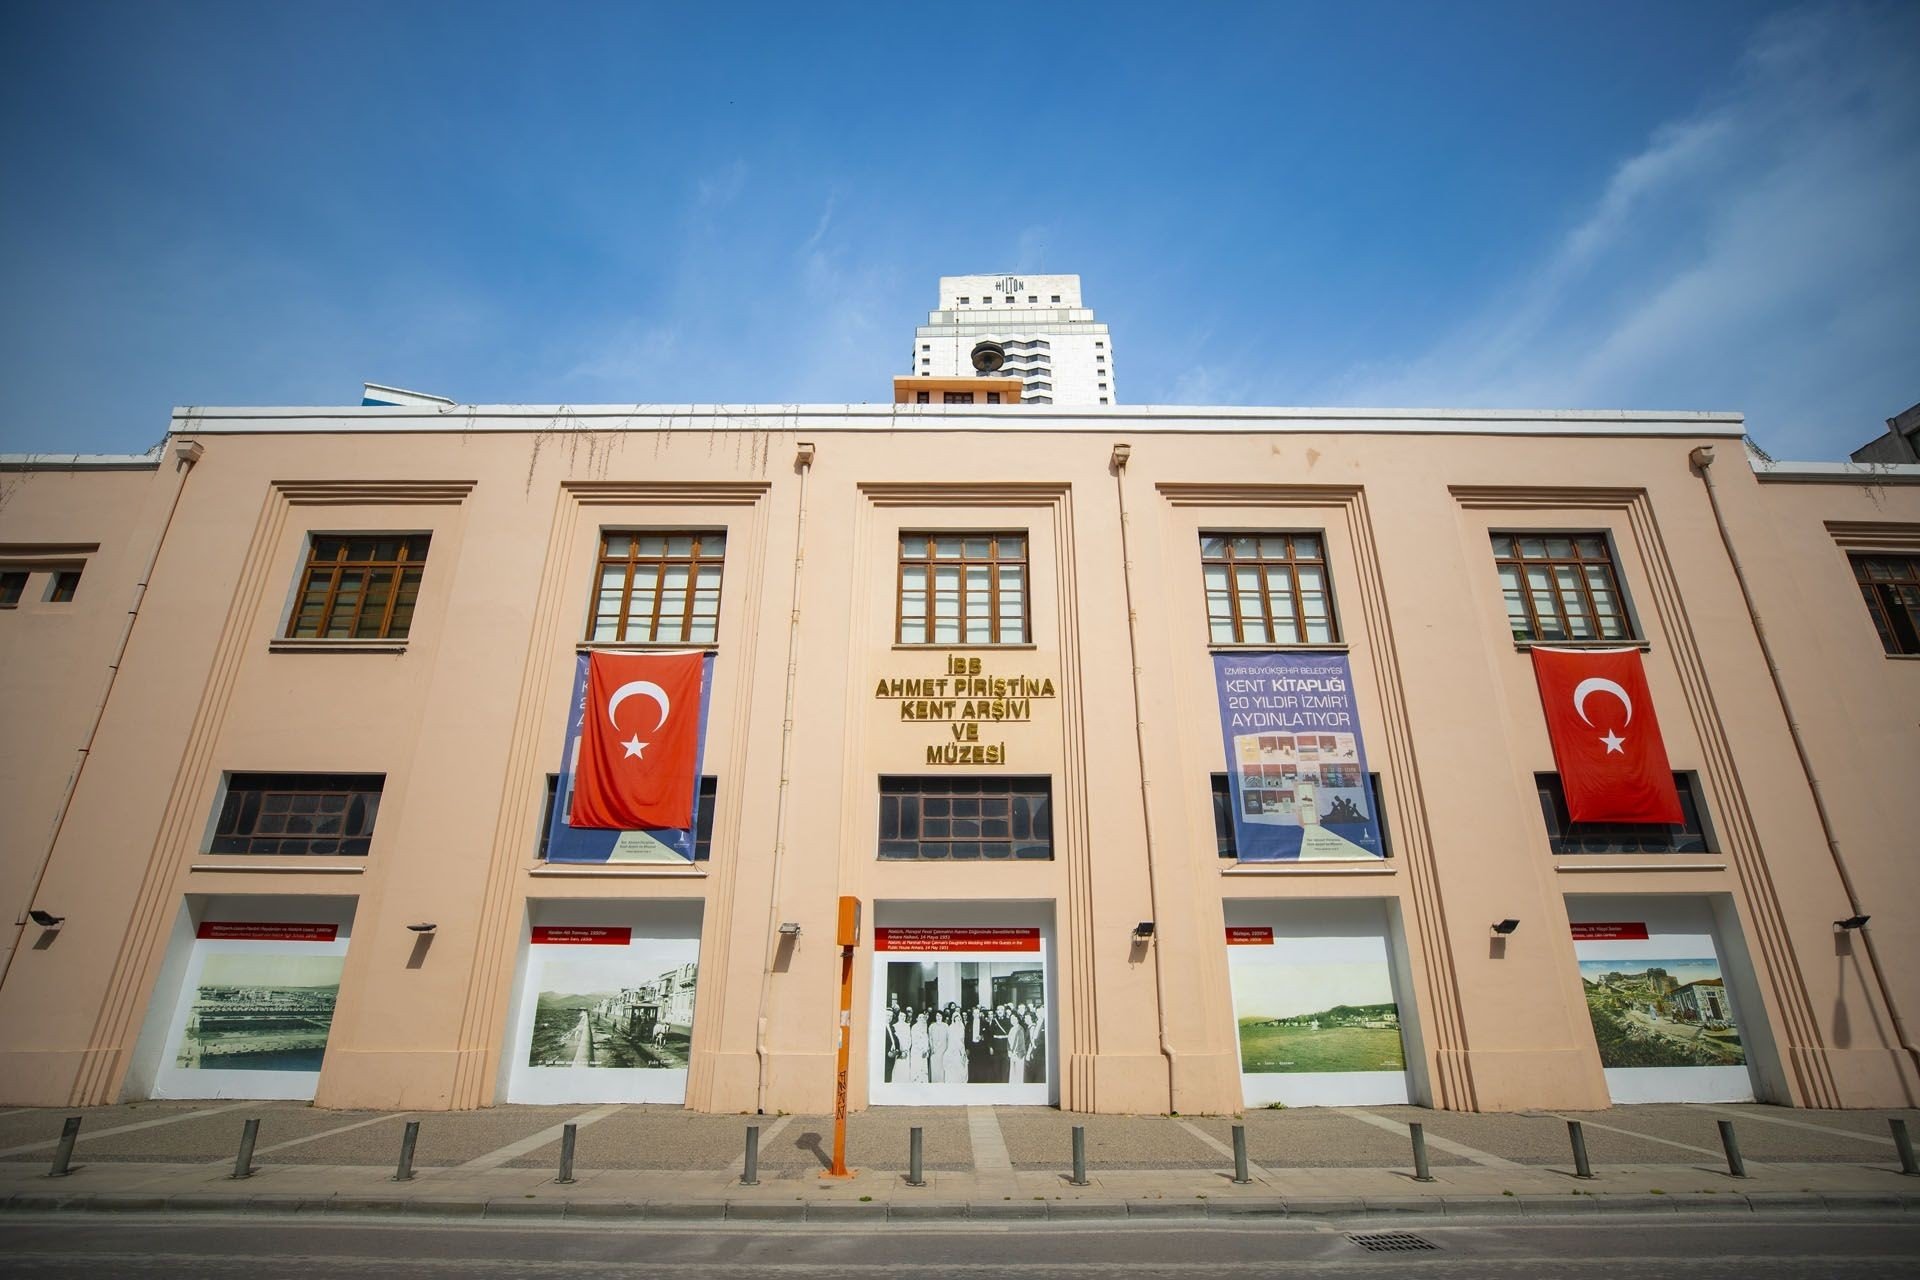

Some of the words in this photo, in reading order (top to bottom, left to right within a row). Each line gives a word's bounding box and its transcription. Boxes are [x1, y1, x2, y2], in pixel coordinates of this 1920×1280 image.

[995, 276, 1024, 295] HILTON
[947, 653, 982, 675] İBB
[875, 678, 948, 697] AHMET
[954, 674, 1056, 700] PİRİŞTİNA
[1226, 679, 1266, 693] KENT
[1271, 676, 1346, 692] KİTAPLIĞI
[900, 700, 956, 720] KENT
[961, 697, 1031, 723] ARŞİVİ
[1228, 696, 1249, 709] 20
[1252, 696, 1298, 709] YILDIR
[1301, 694, 1349, 708] İZMİR'İ
[1231, 712, 1351, 727] AYDINLATIYOR
[951, 722, 979, 741] VE
[925, 742, 1005, 764] MÜZESİ
